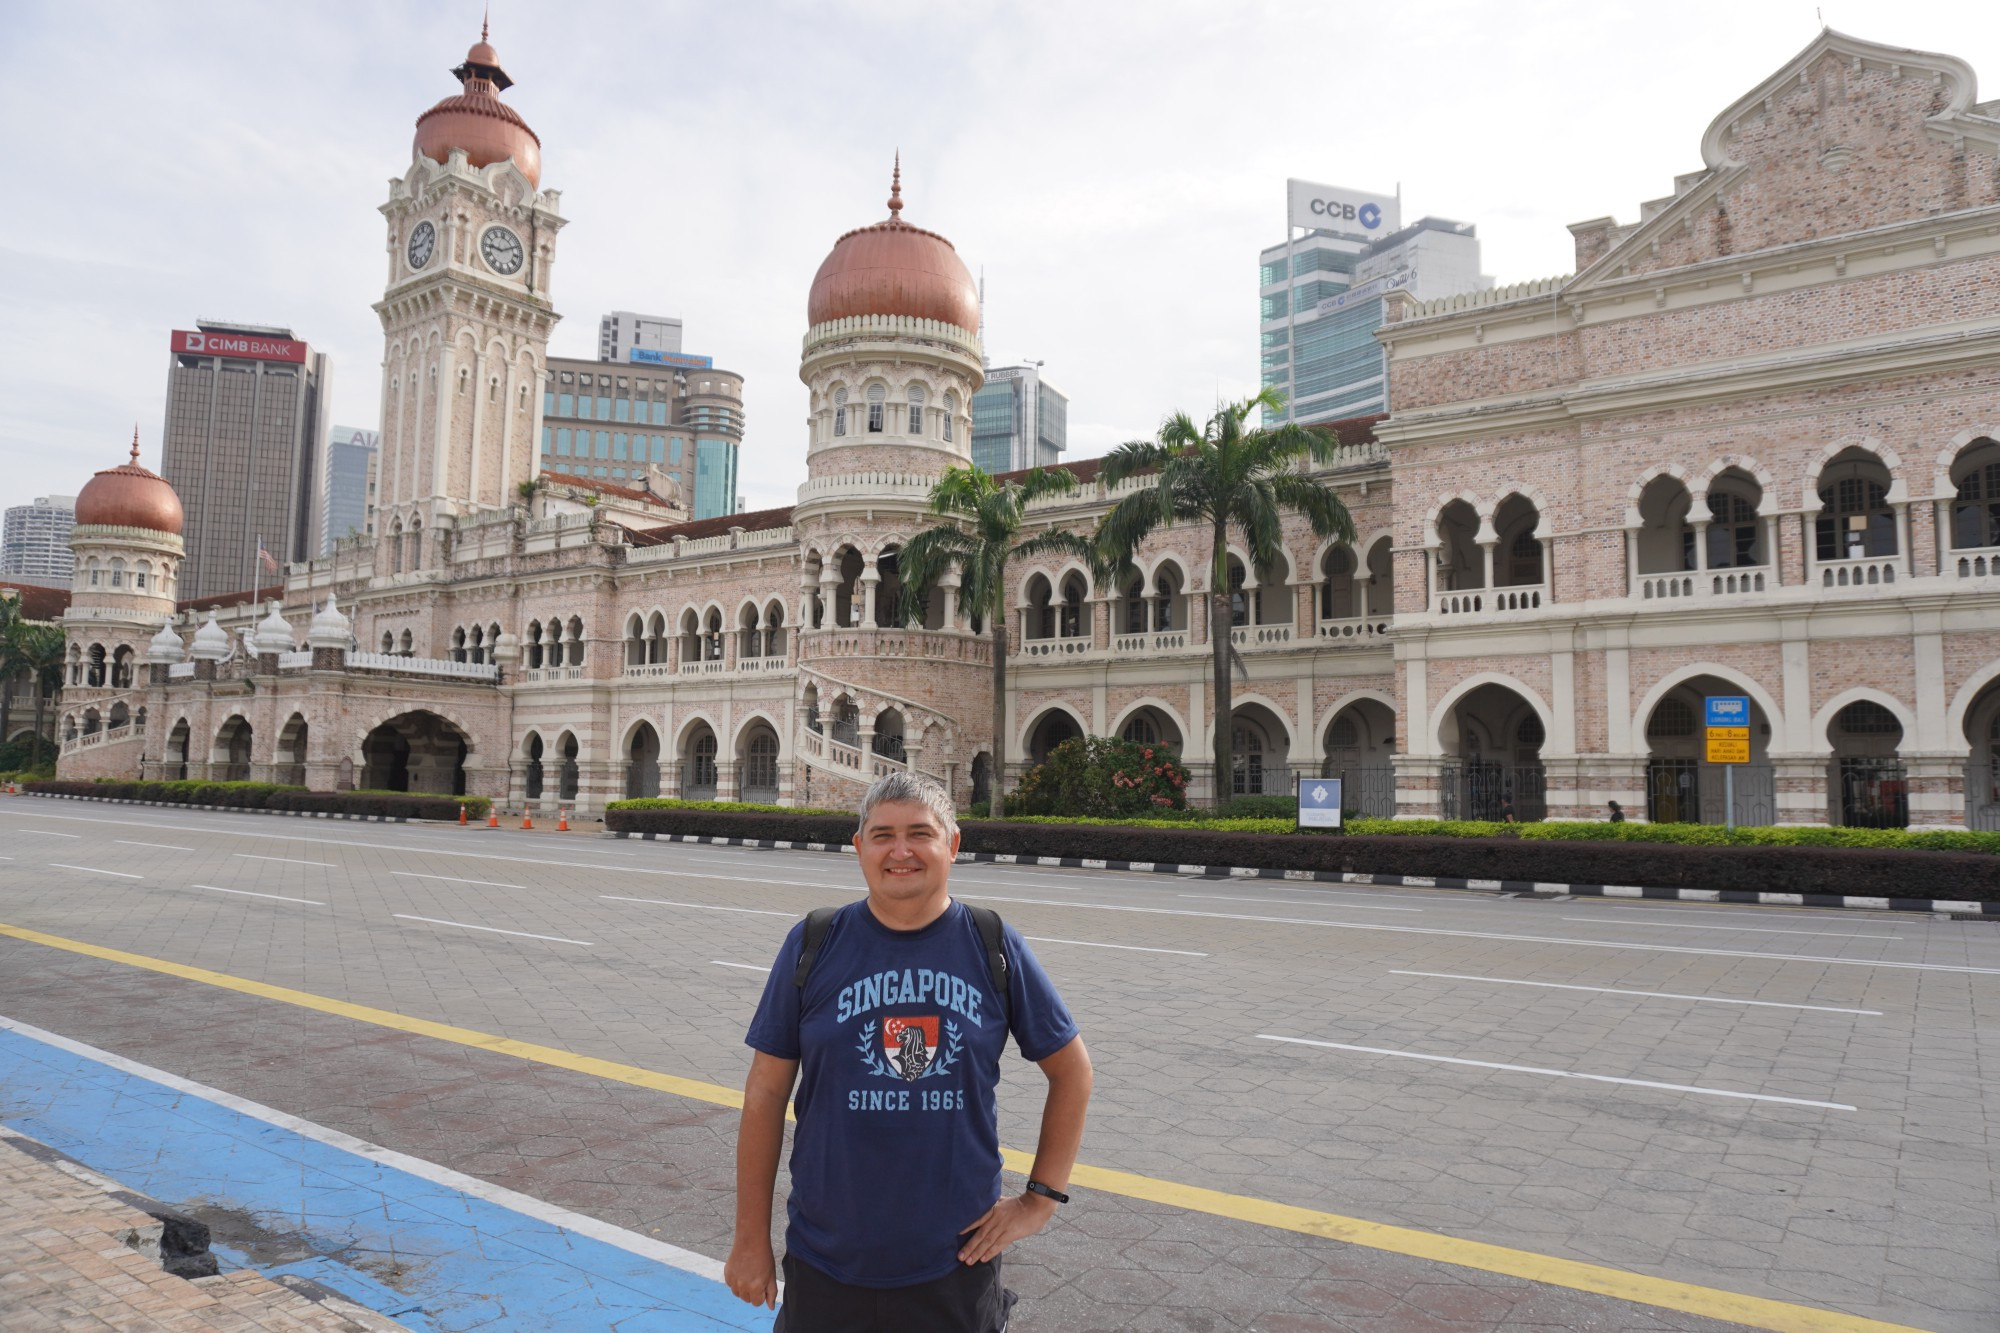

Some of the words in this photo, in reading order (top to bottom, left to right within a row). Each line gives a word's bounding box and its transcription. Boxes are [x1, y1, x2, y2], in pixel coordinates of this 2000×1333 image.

[1310, 198, 1356, 220] CCB
[1411, 267, 1418, 279] 6
[208, 338, 248, 352] CIMB
[251, 342, 291, 356] BANK
[638, 351, 662, 361] Bank
[991, 370, 1019, 380] RUBBER
[1709, 730, 1714, 738] 6
[1728, 730, 1732, 738] 8
[836, 968, 982, 1028] SINGAPORE
[848, 1089, 910, 1111] SINCE
[921, 1089, 964, 1111] 1965
